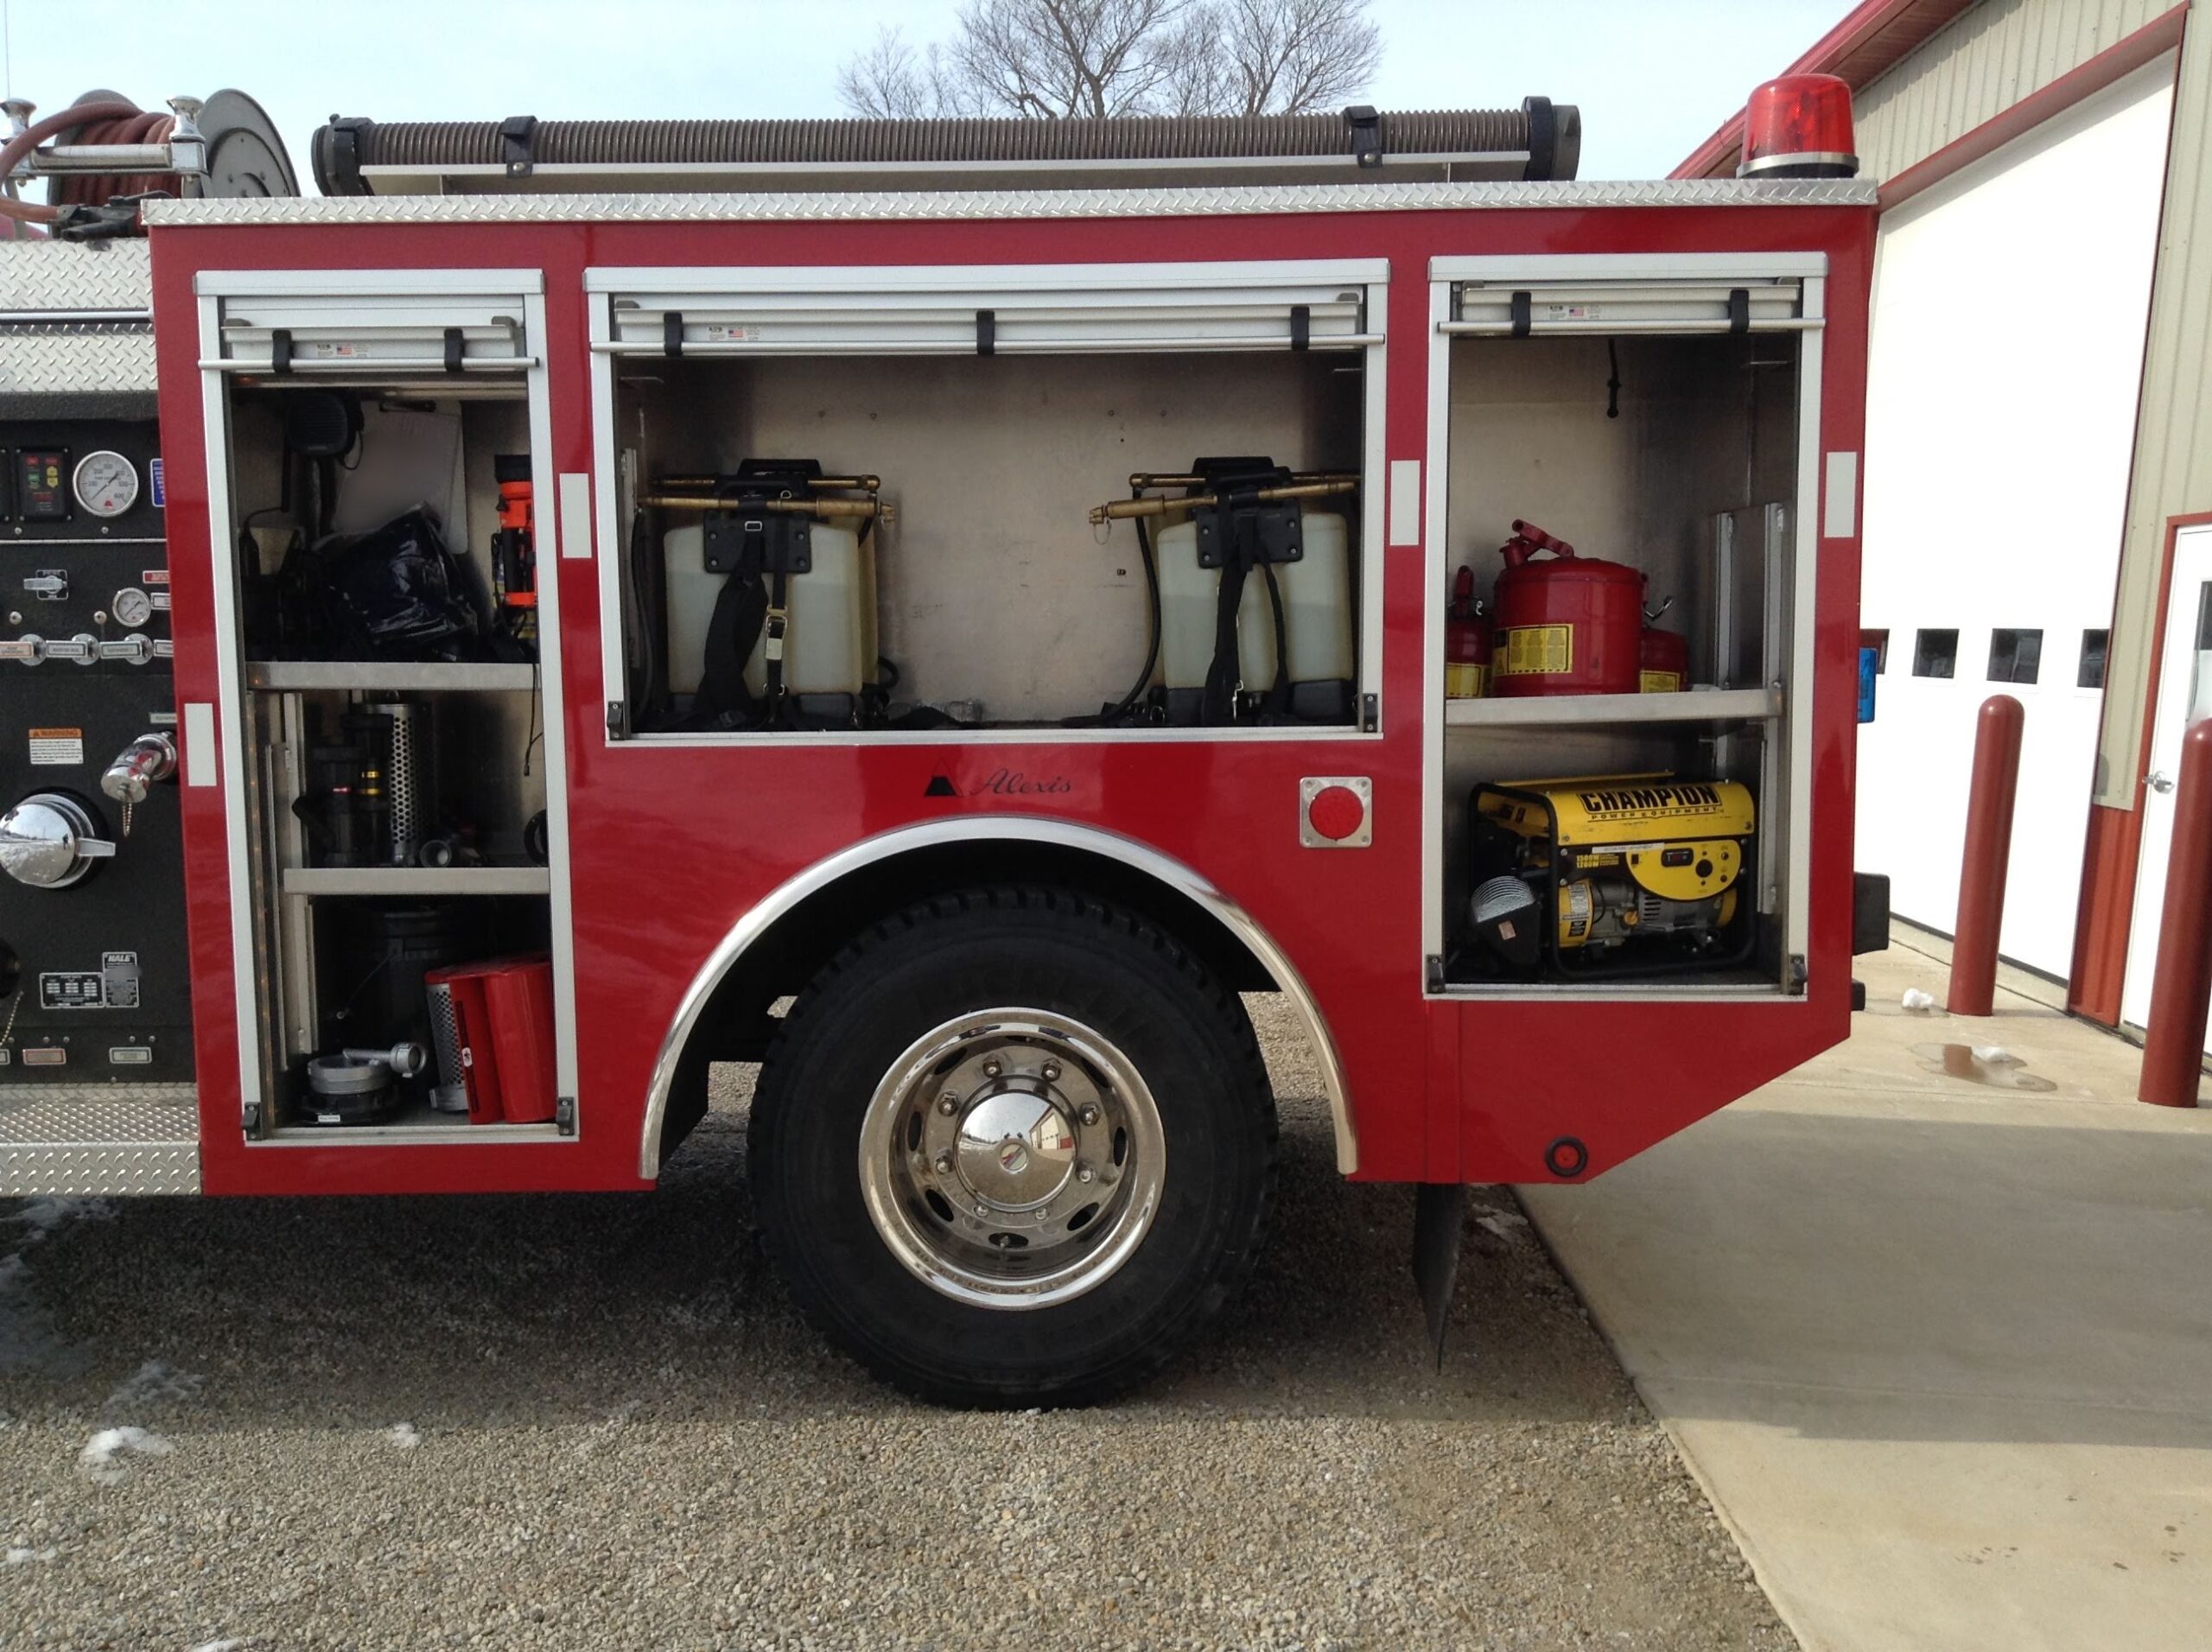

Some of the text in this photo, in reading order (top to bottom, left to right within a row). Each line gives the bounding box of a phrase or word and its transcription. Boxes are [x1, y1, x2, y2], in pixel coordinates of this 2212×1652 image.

[969, 767, 1071, 794] Alexis
[1580, 786, 1719, 812] CHAMPION
[1642, 807, 1717, 817] EQUIPMENT
